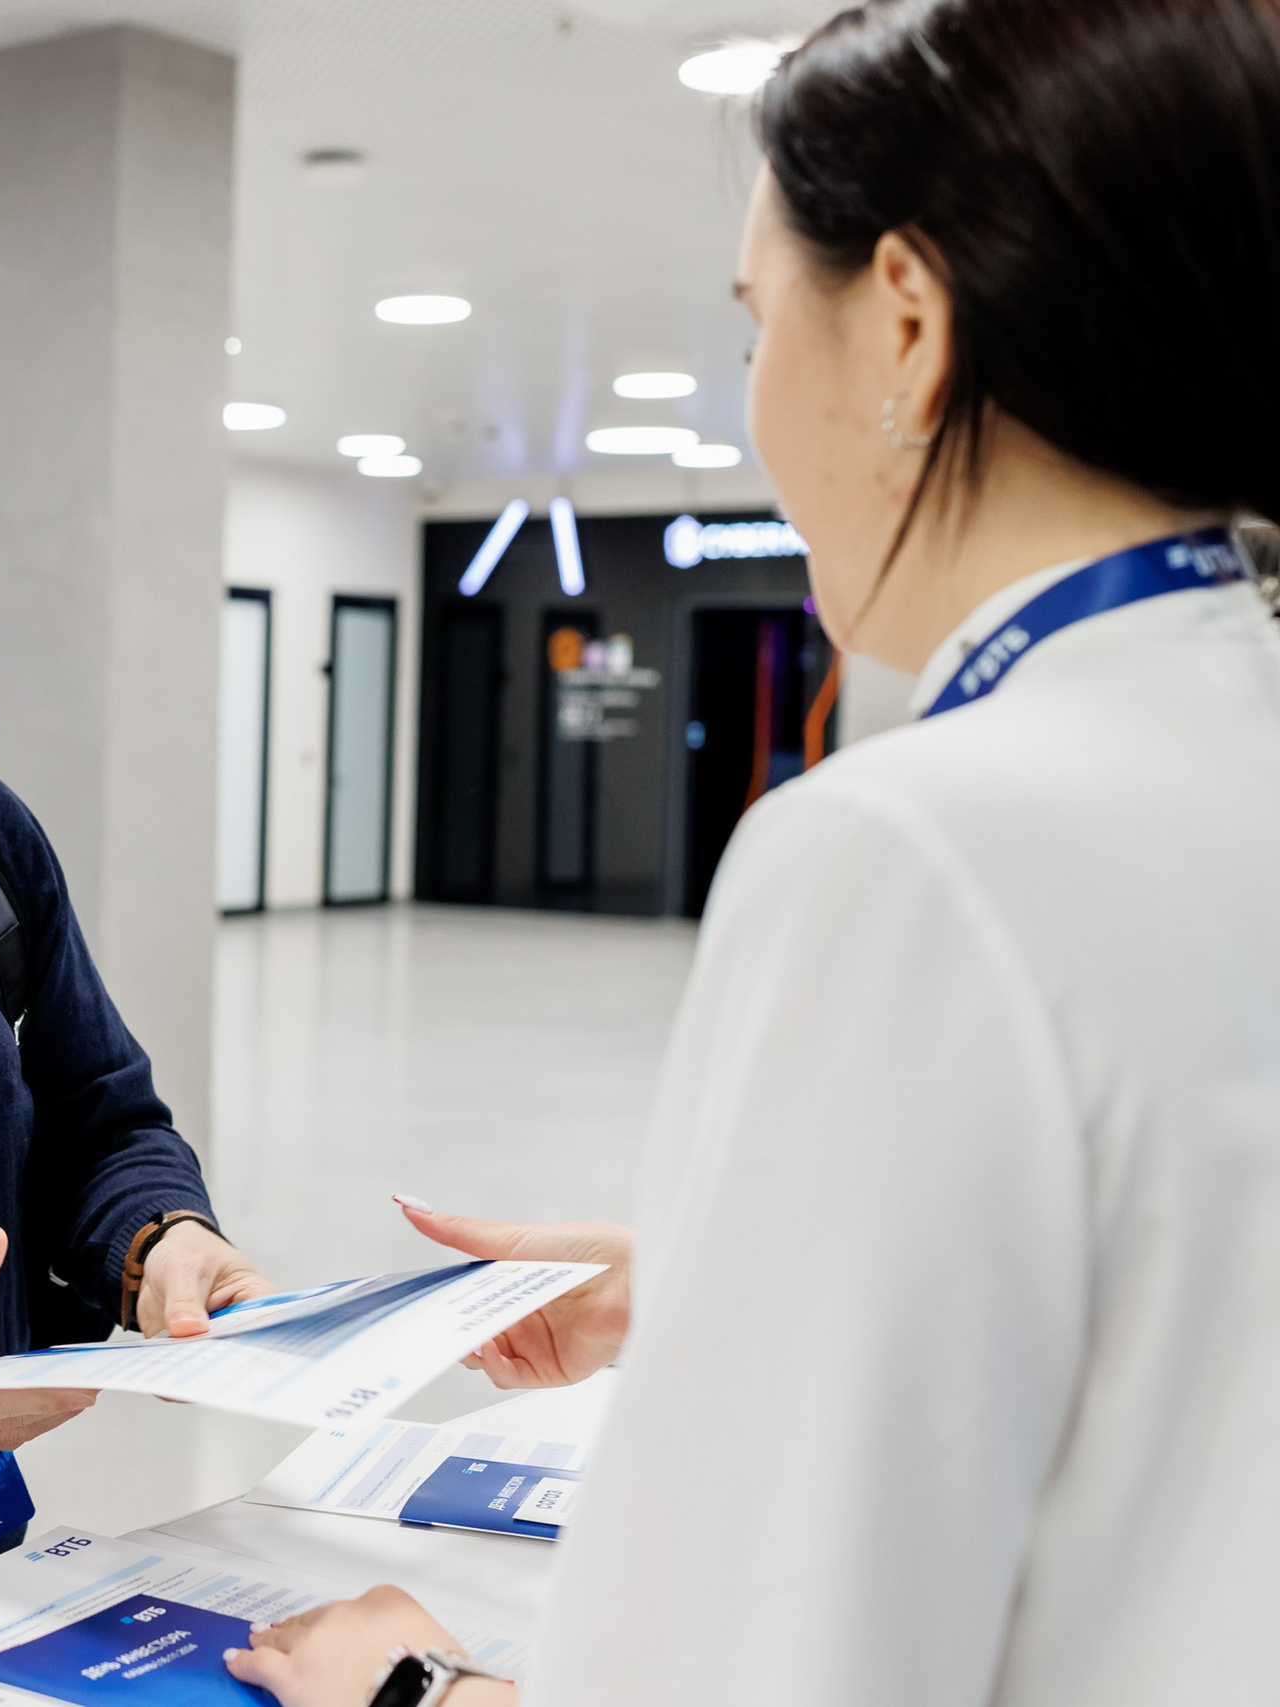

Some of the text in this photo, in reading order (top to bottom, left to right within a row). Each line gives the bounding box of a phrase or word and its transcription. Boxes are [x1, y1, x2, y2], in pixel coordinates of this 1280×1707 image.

[487, 1498, 508, 1511] ДЕНЬ
[44, 1536, 93, 1557] ВТБ
[133, 1605, 167, 1623] ВТБ
[81, 1628, 193, 1681] ДЕНЬ ИНВЕСТОРА
